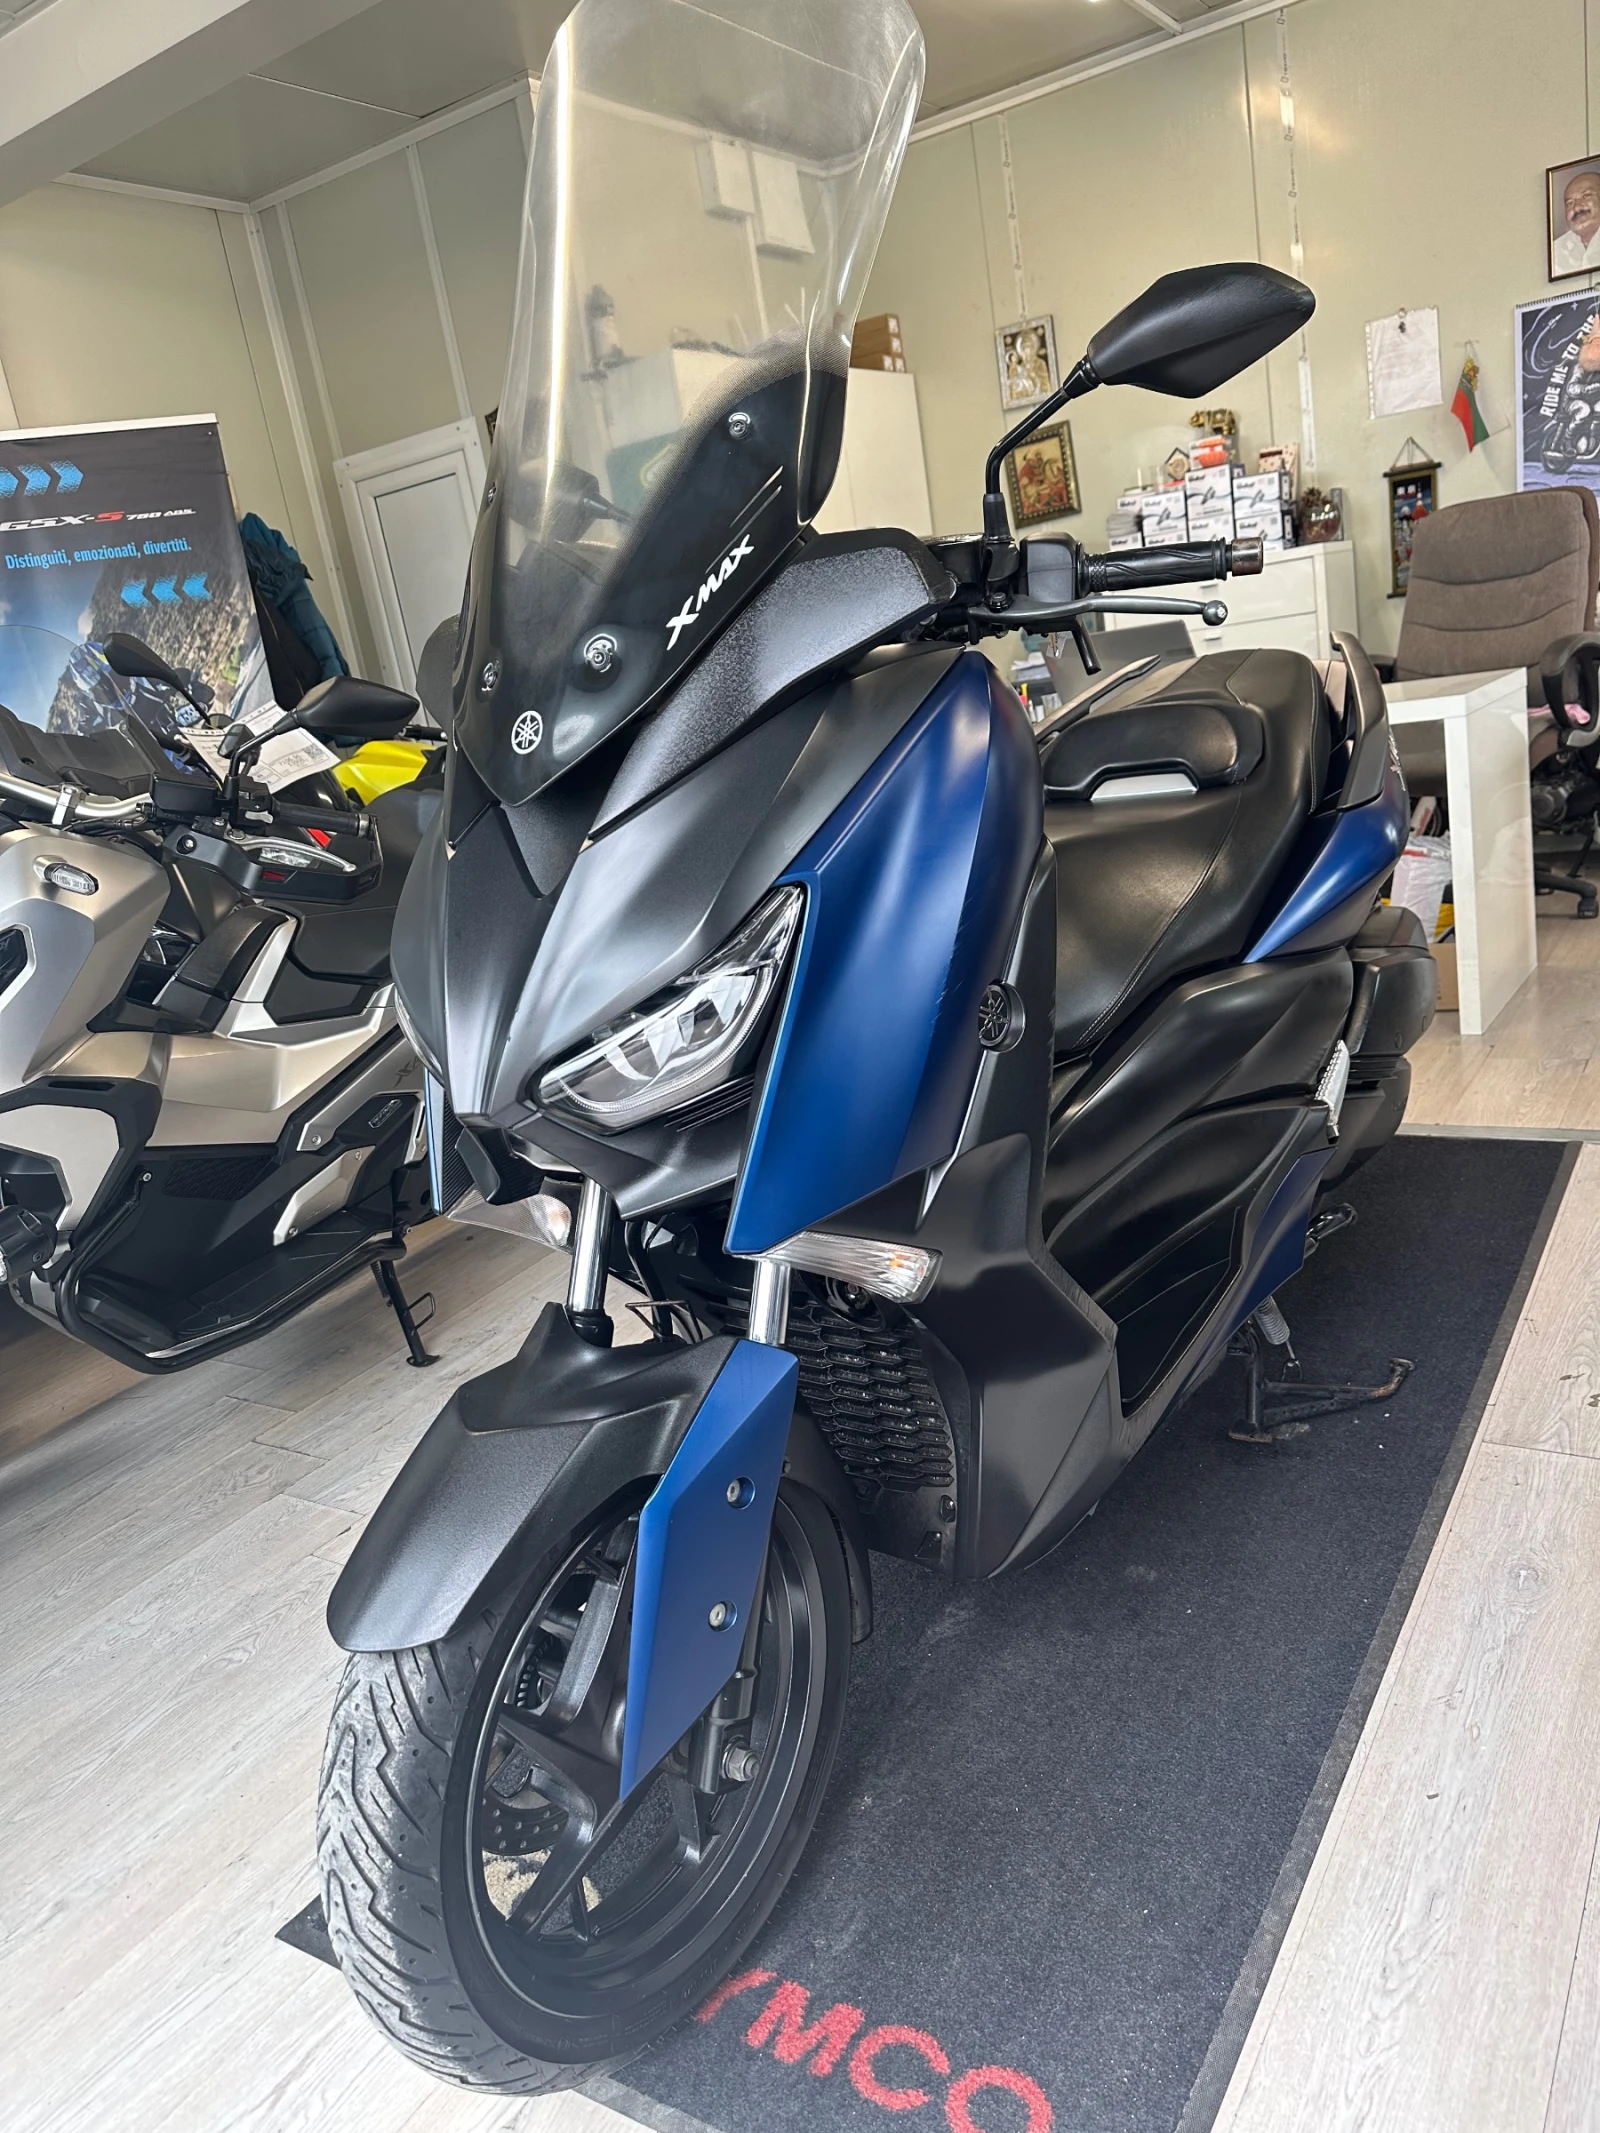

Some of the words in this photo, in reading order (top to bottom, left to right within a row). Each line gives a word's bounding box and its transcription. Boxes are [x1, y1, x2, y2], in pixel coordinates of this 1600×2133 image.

[1540, 386, 1560, 417] RIDE
[1550, 364, 1569, 385] ME
[1561, 342, 1580, 360] TO
[0, 511, 125, 532] GSX-S
[5, 550, 71, 569] Distinguiti,
[74, 541, 141, 563] emozionati,
[143, 537, 192, 555] divertiti.
[665, 533, 755, 651] XMAX
